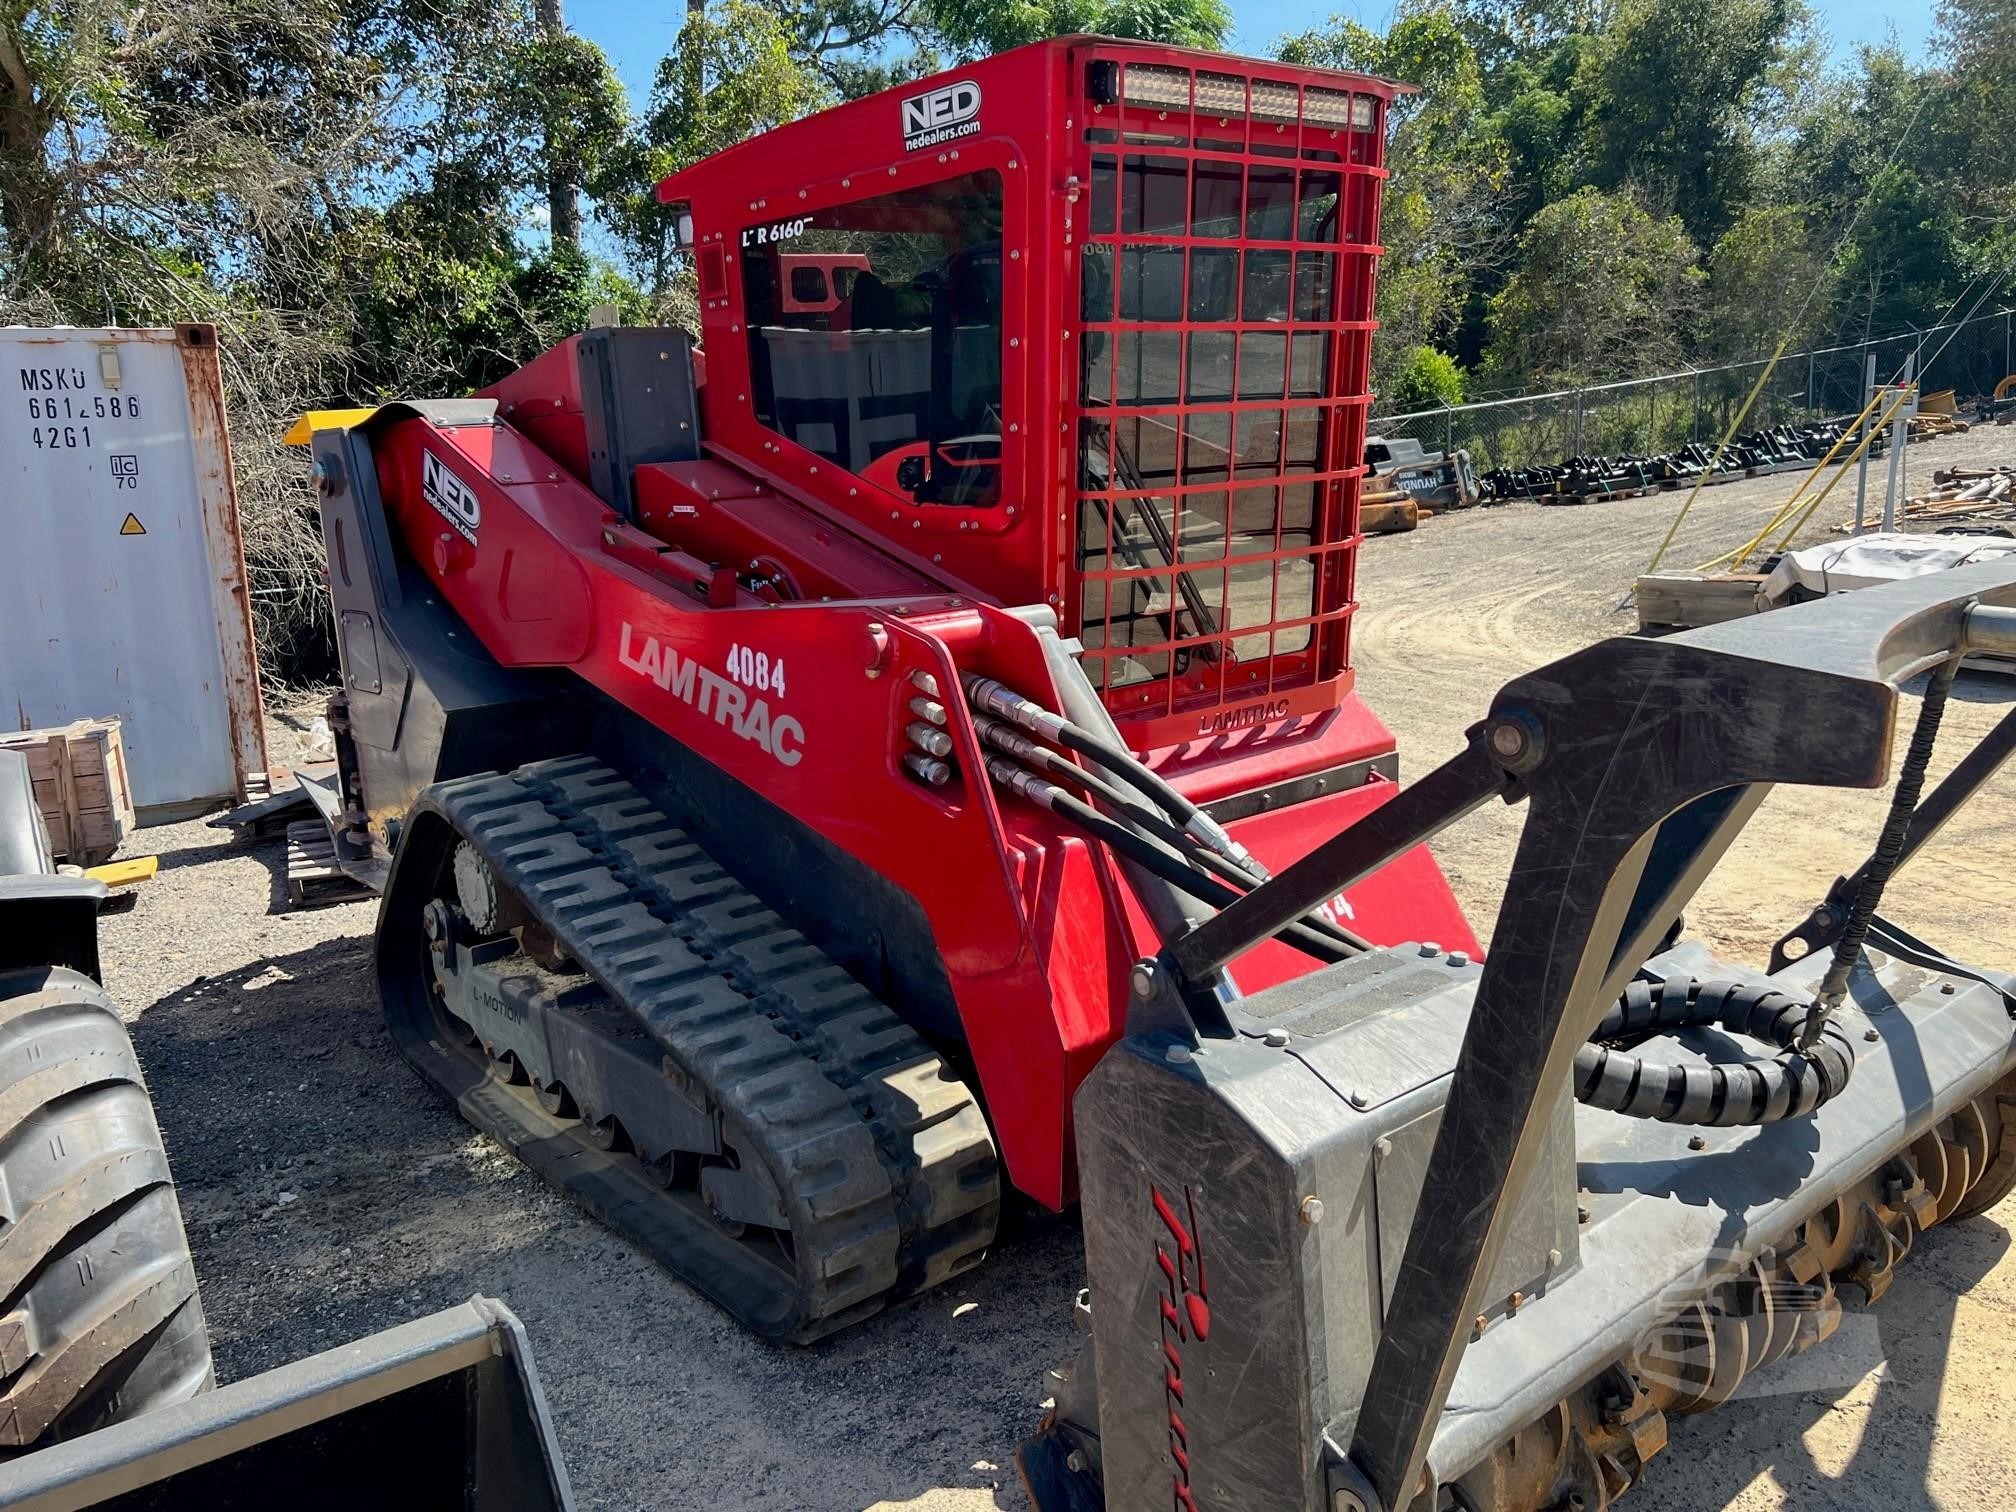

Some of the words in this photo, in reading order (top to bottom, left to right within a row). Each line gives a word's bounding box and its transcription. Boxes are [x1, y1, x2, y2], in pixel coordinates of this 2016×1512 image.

[903, 82, 980, 135] NED
[905, 120, 980, 151] nedealers.com
[742, 227, 767, 247] LR
[20, 368, 86, 391] MSKU
[33, 426, 91, 449] 42G1
[116, 476, 138, 489] 70
[424, 450, 481, 527] NED
[423, 488, 478, 547] nedealers.com
[726, 643, 786, 699] 4084
[618, 621, 805, 767] LAMTRAC
[1198, 699, 1290, 735] LAMTRAC
[473, 986, 523, 1026] L-MOTION
